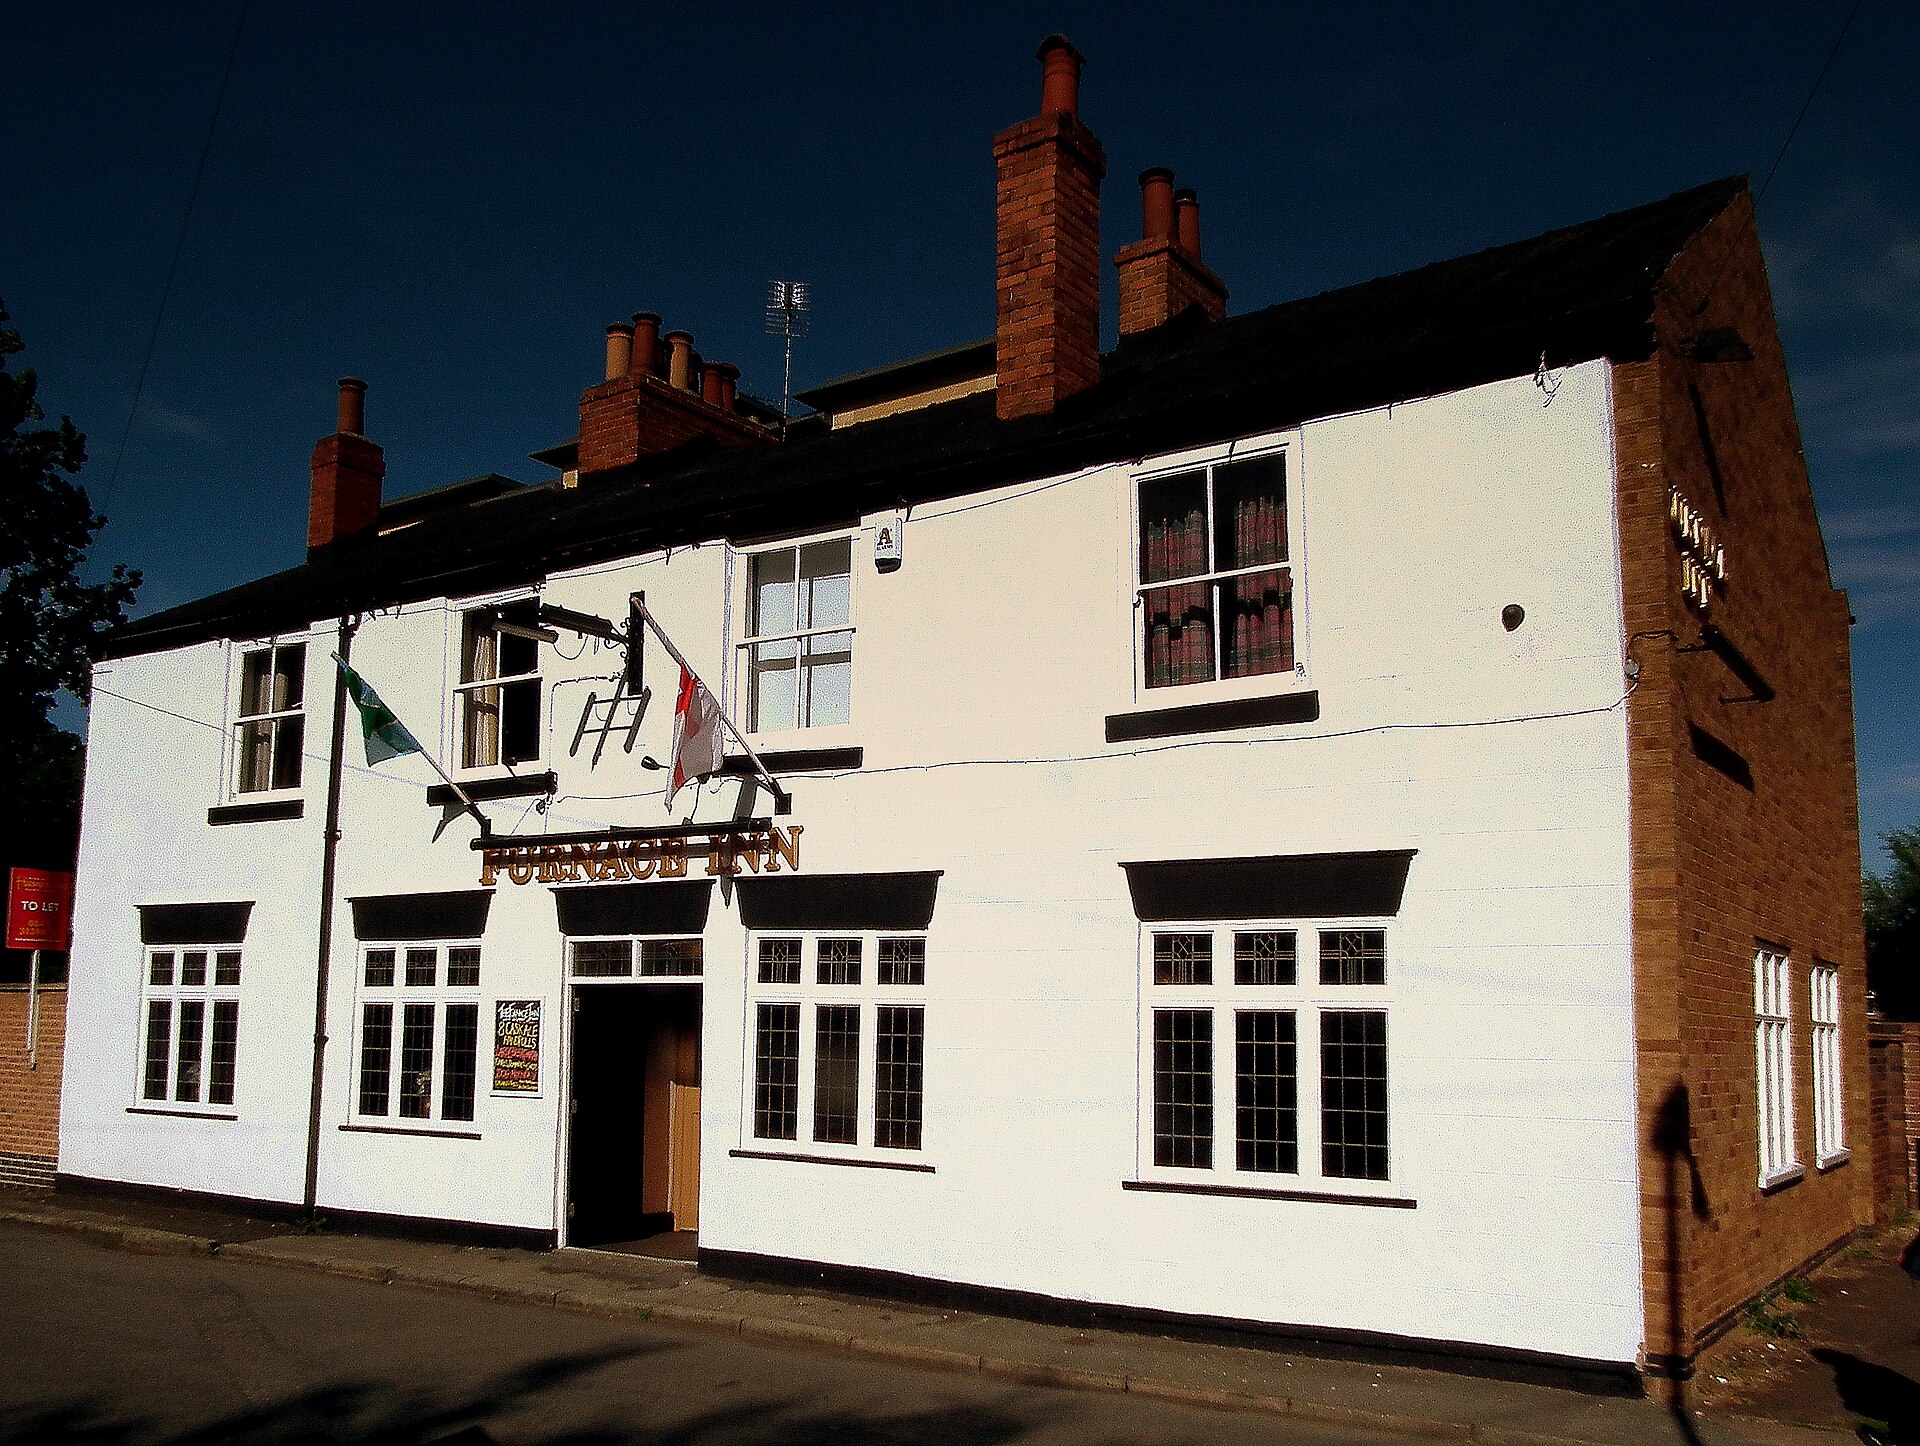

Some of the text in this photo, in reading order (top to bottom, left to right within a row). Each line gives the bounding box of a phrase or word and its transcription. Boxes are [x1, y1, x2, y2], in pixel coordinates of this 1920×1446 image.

[479, 825, 804, 886] FURNACE INN
[21, 900, 60, 912] TO LET
